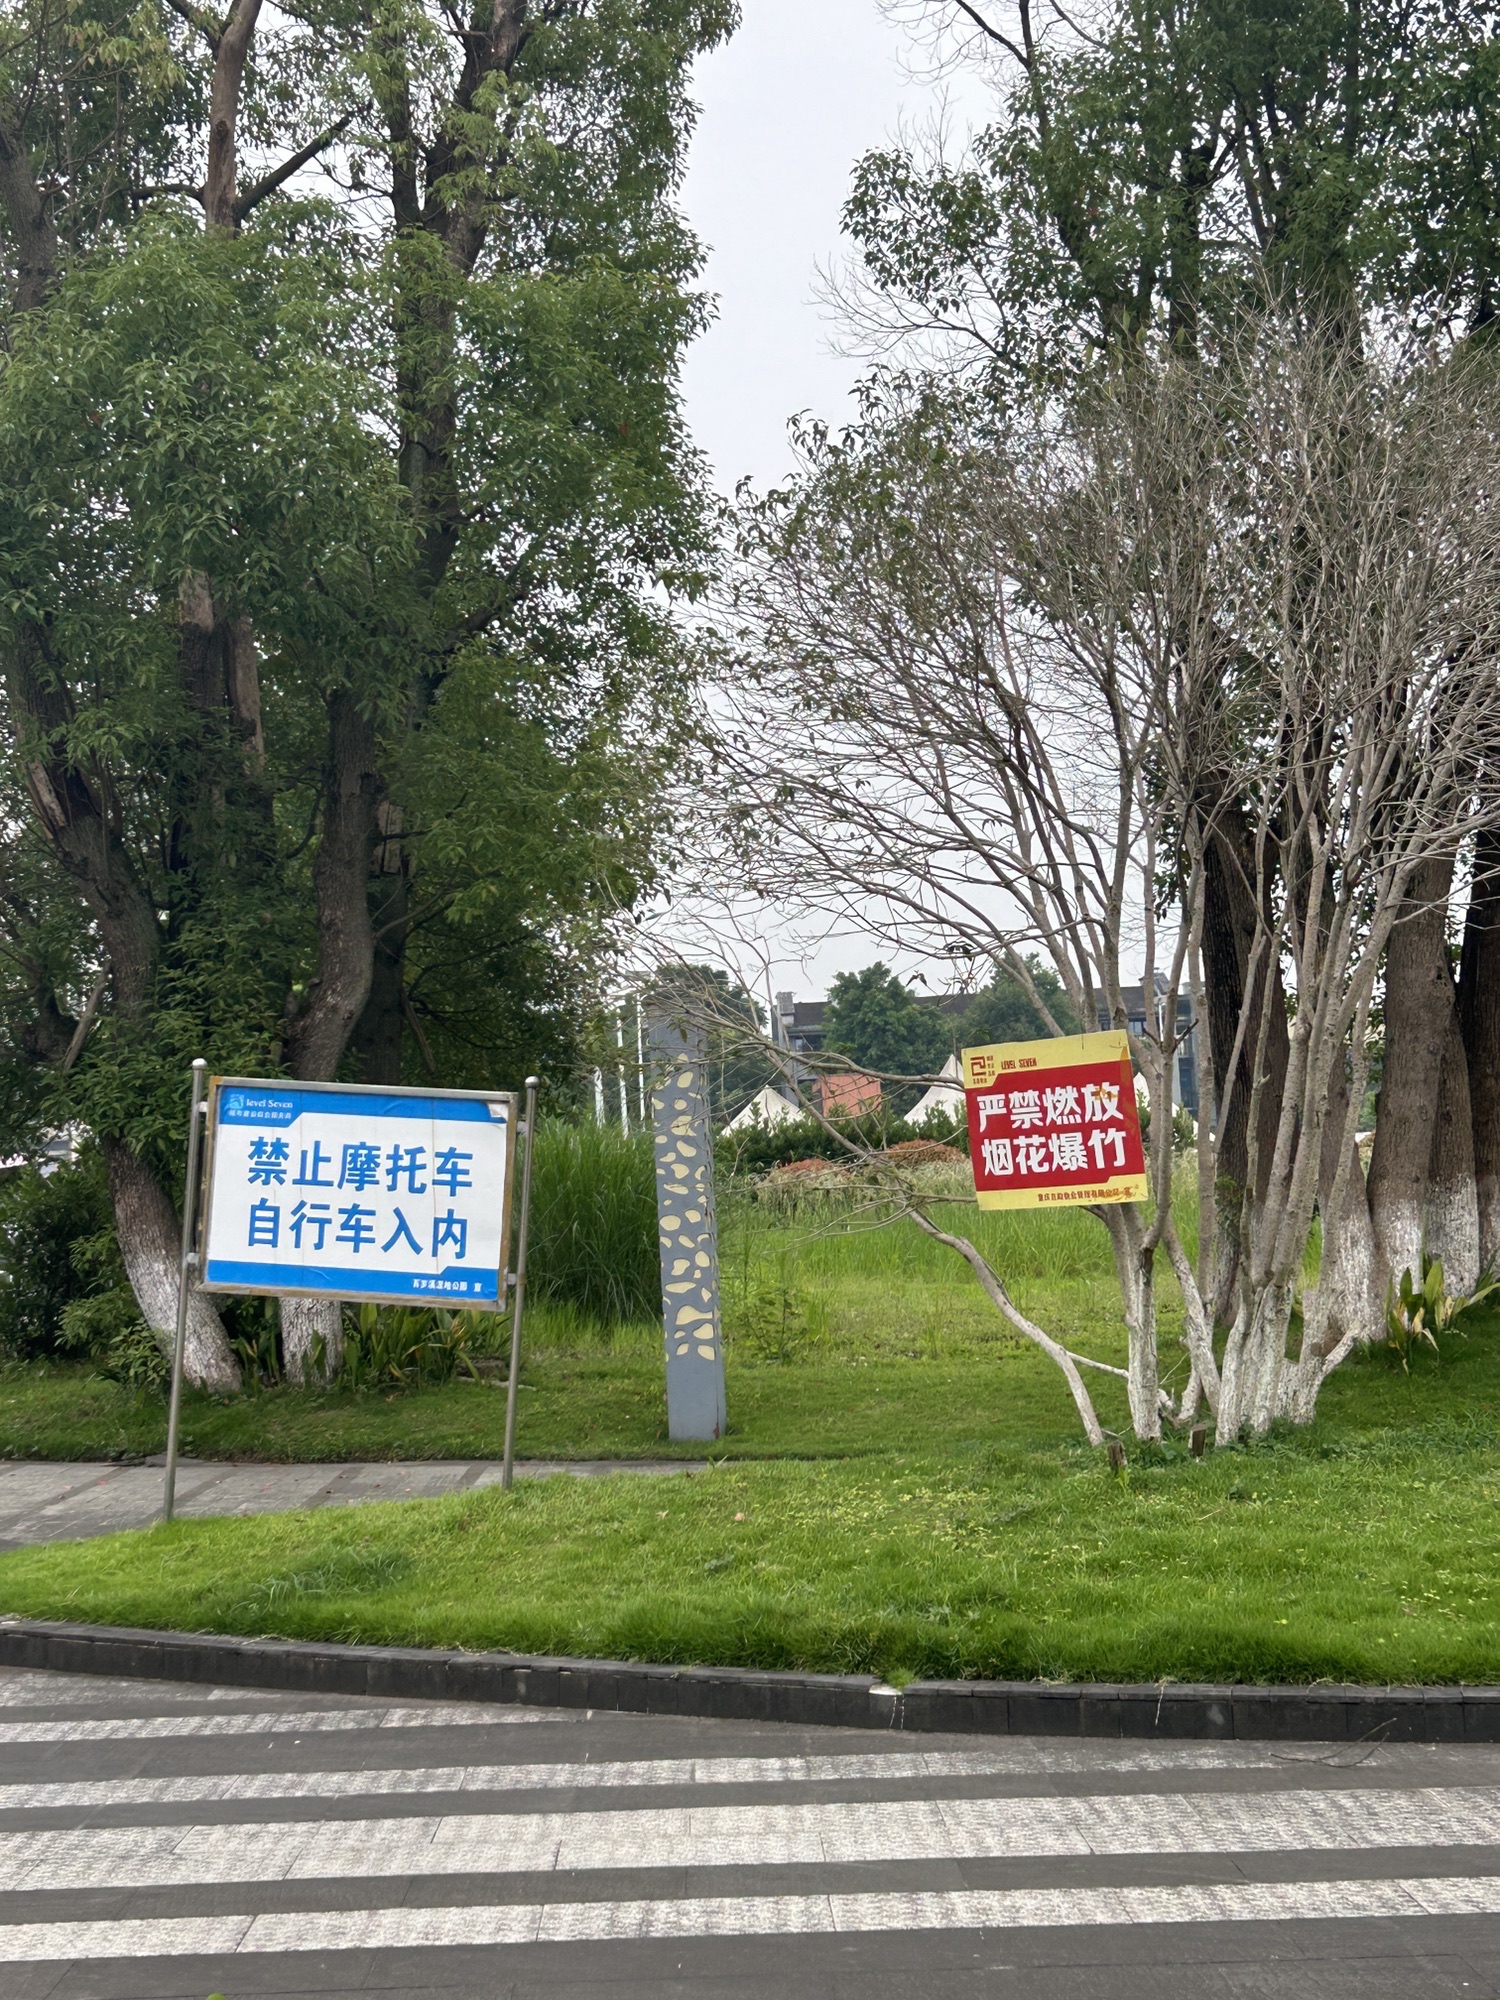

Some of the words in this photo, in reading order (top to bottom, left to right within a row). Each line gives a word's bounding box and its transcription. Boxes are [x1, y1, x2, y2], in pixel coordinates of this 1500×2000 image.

[1018, 1057, 1037, 1068] SEVEN
[267, 1099, 293, 1109] Seven
[976, 1081, 1124, 1133] 严禁燃放
[247, 1135, 473, 1198] 禁止摩托车
[981, 1127, 1127, 1176] 烟花爆竹
[247, 1197, 468, 1260] 自行车入内
